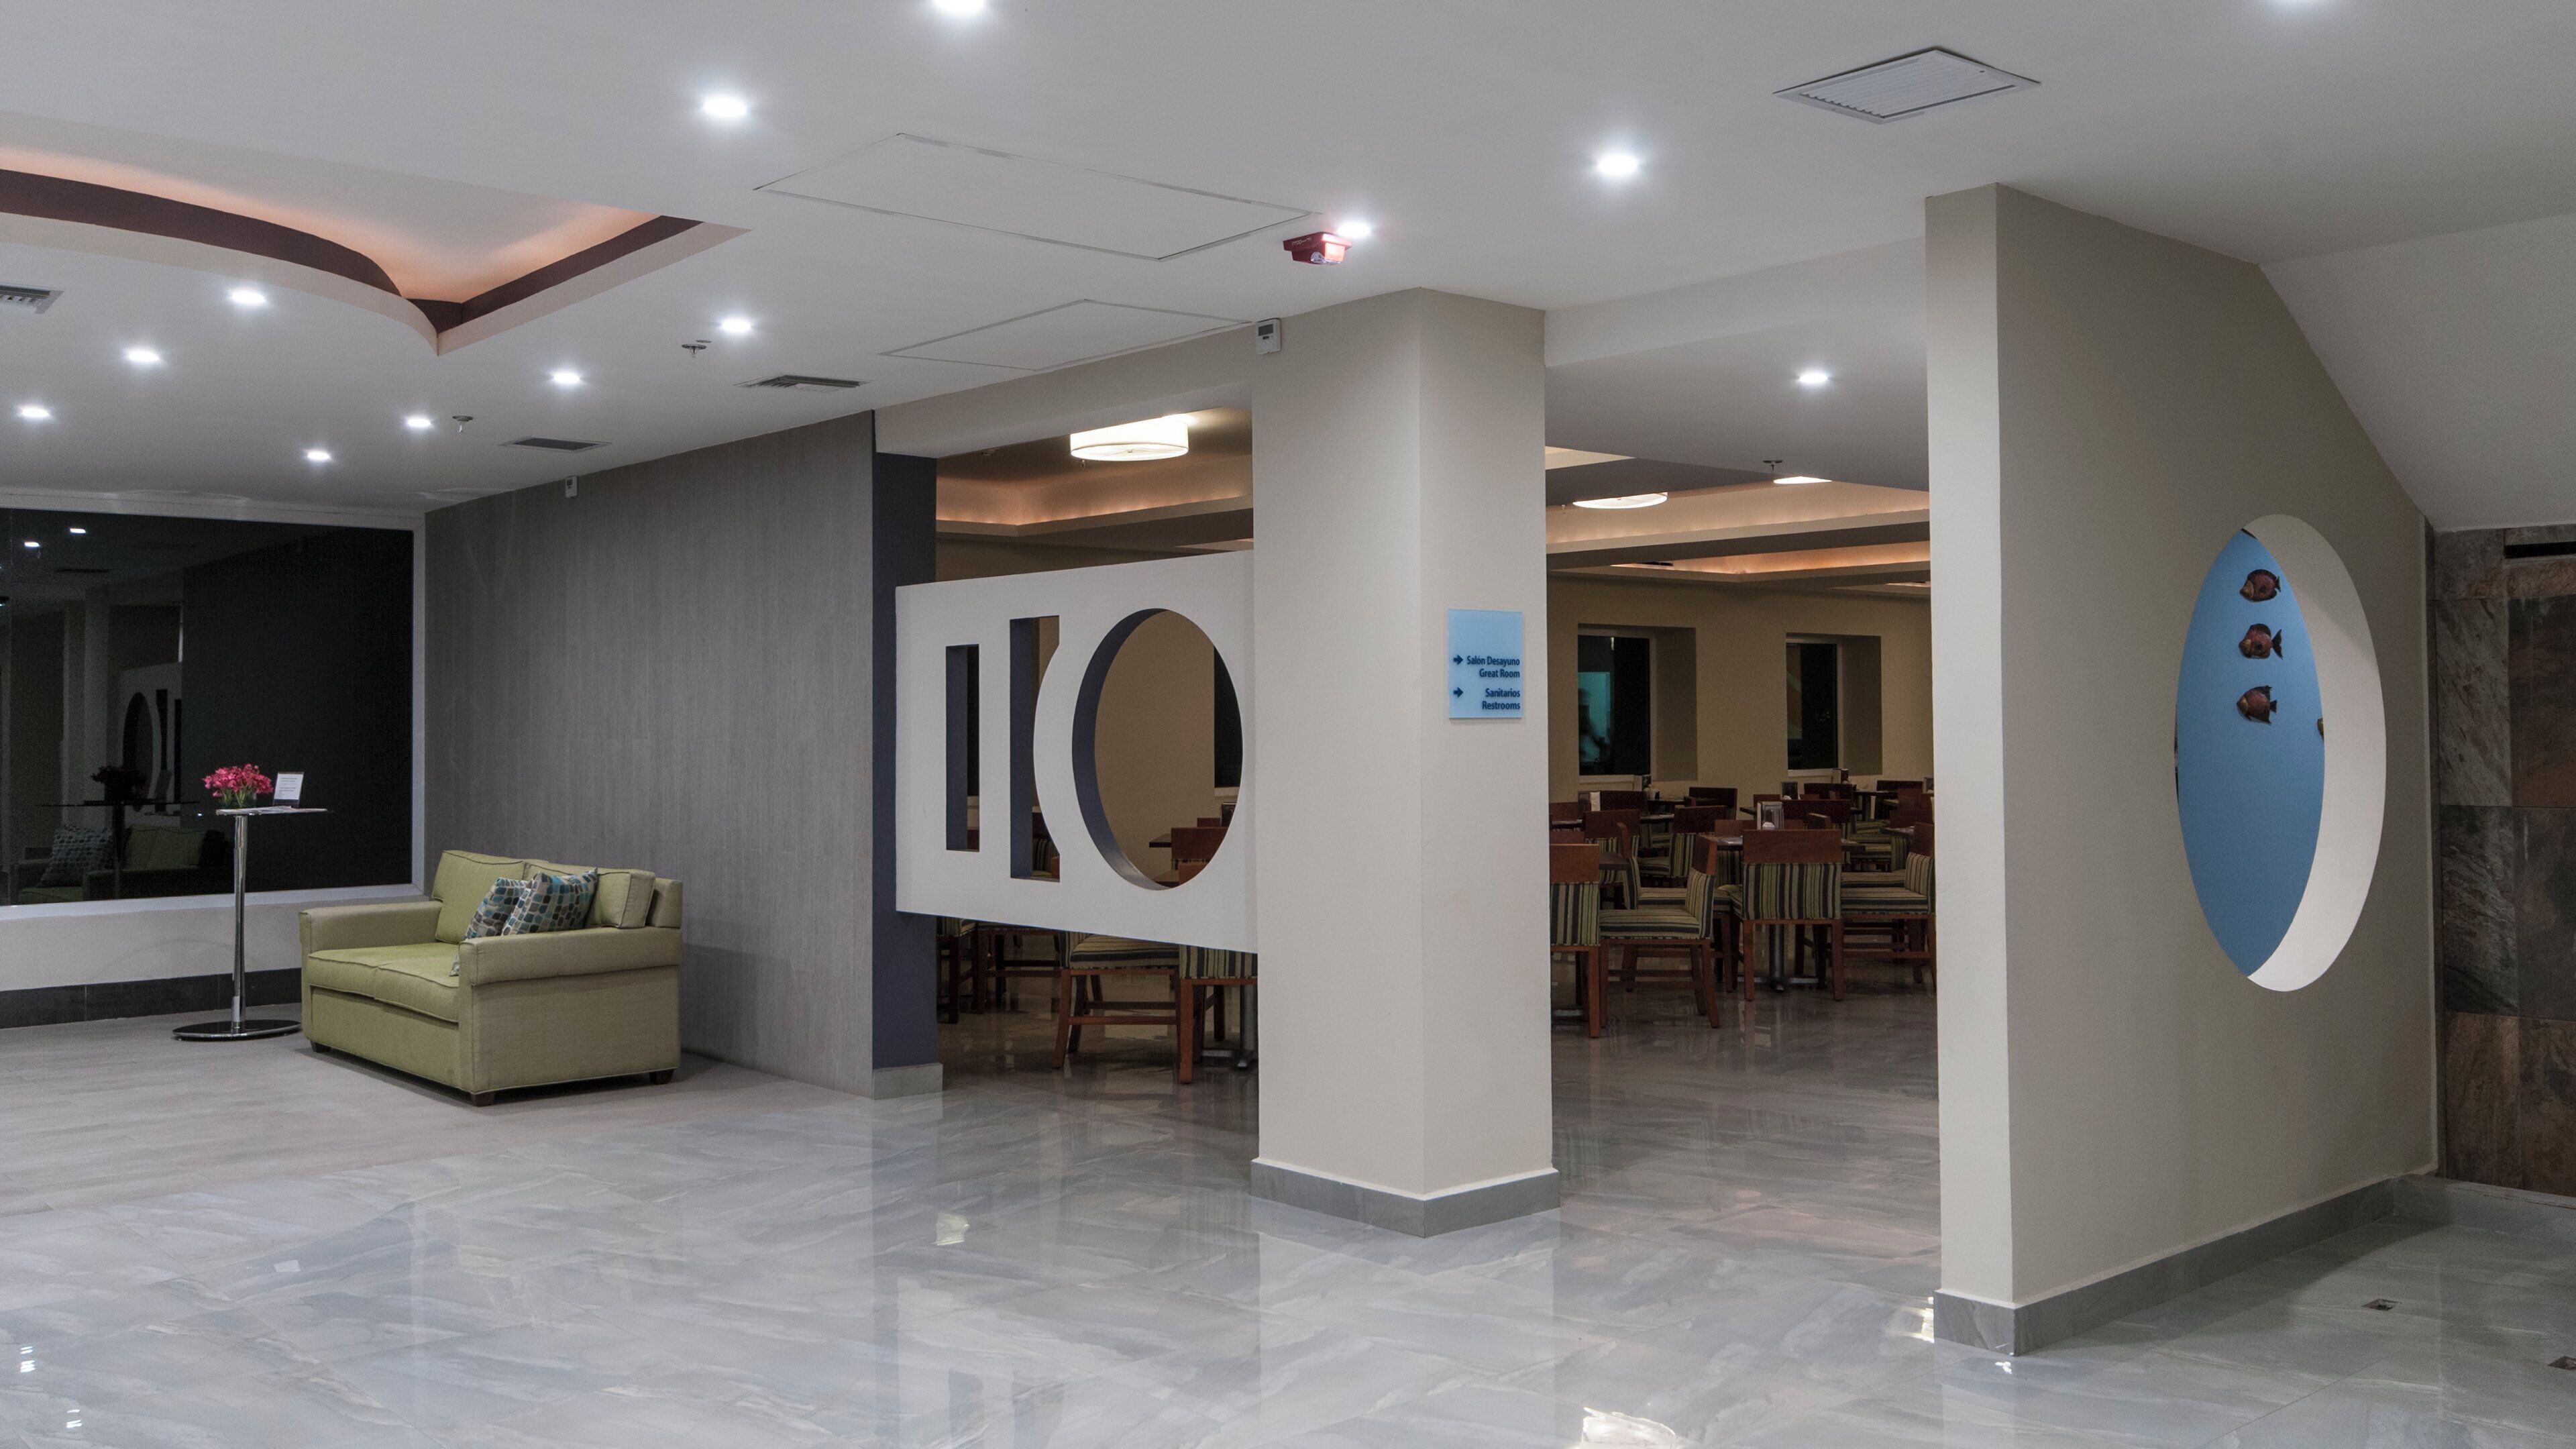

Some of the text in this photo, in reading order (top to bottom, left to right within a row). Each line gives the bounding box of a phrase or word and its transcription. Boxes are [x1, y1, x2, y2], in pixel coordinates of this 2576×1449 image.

[1466, 655, 1520, 667] Salón Desayuno
[1479, 668, 1520, 678] Great Room
[1485, 688, 1521, 698] Sanitarios
[1482, 700, 1521, 710] Restrooms
